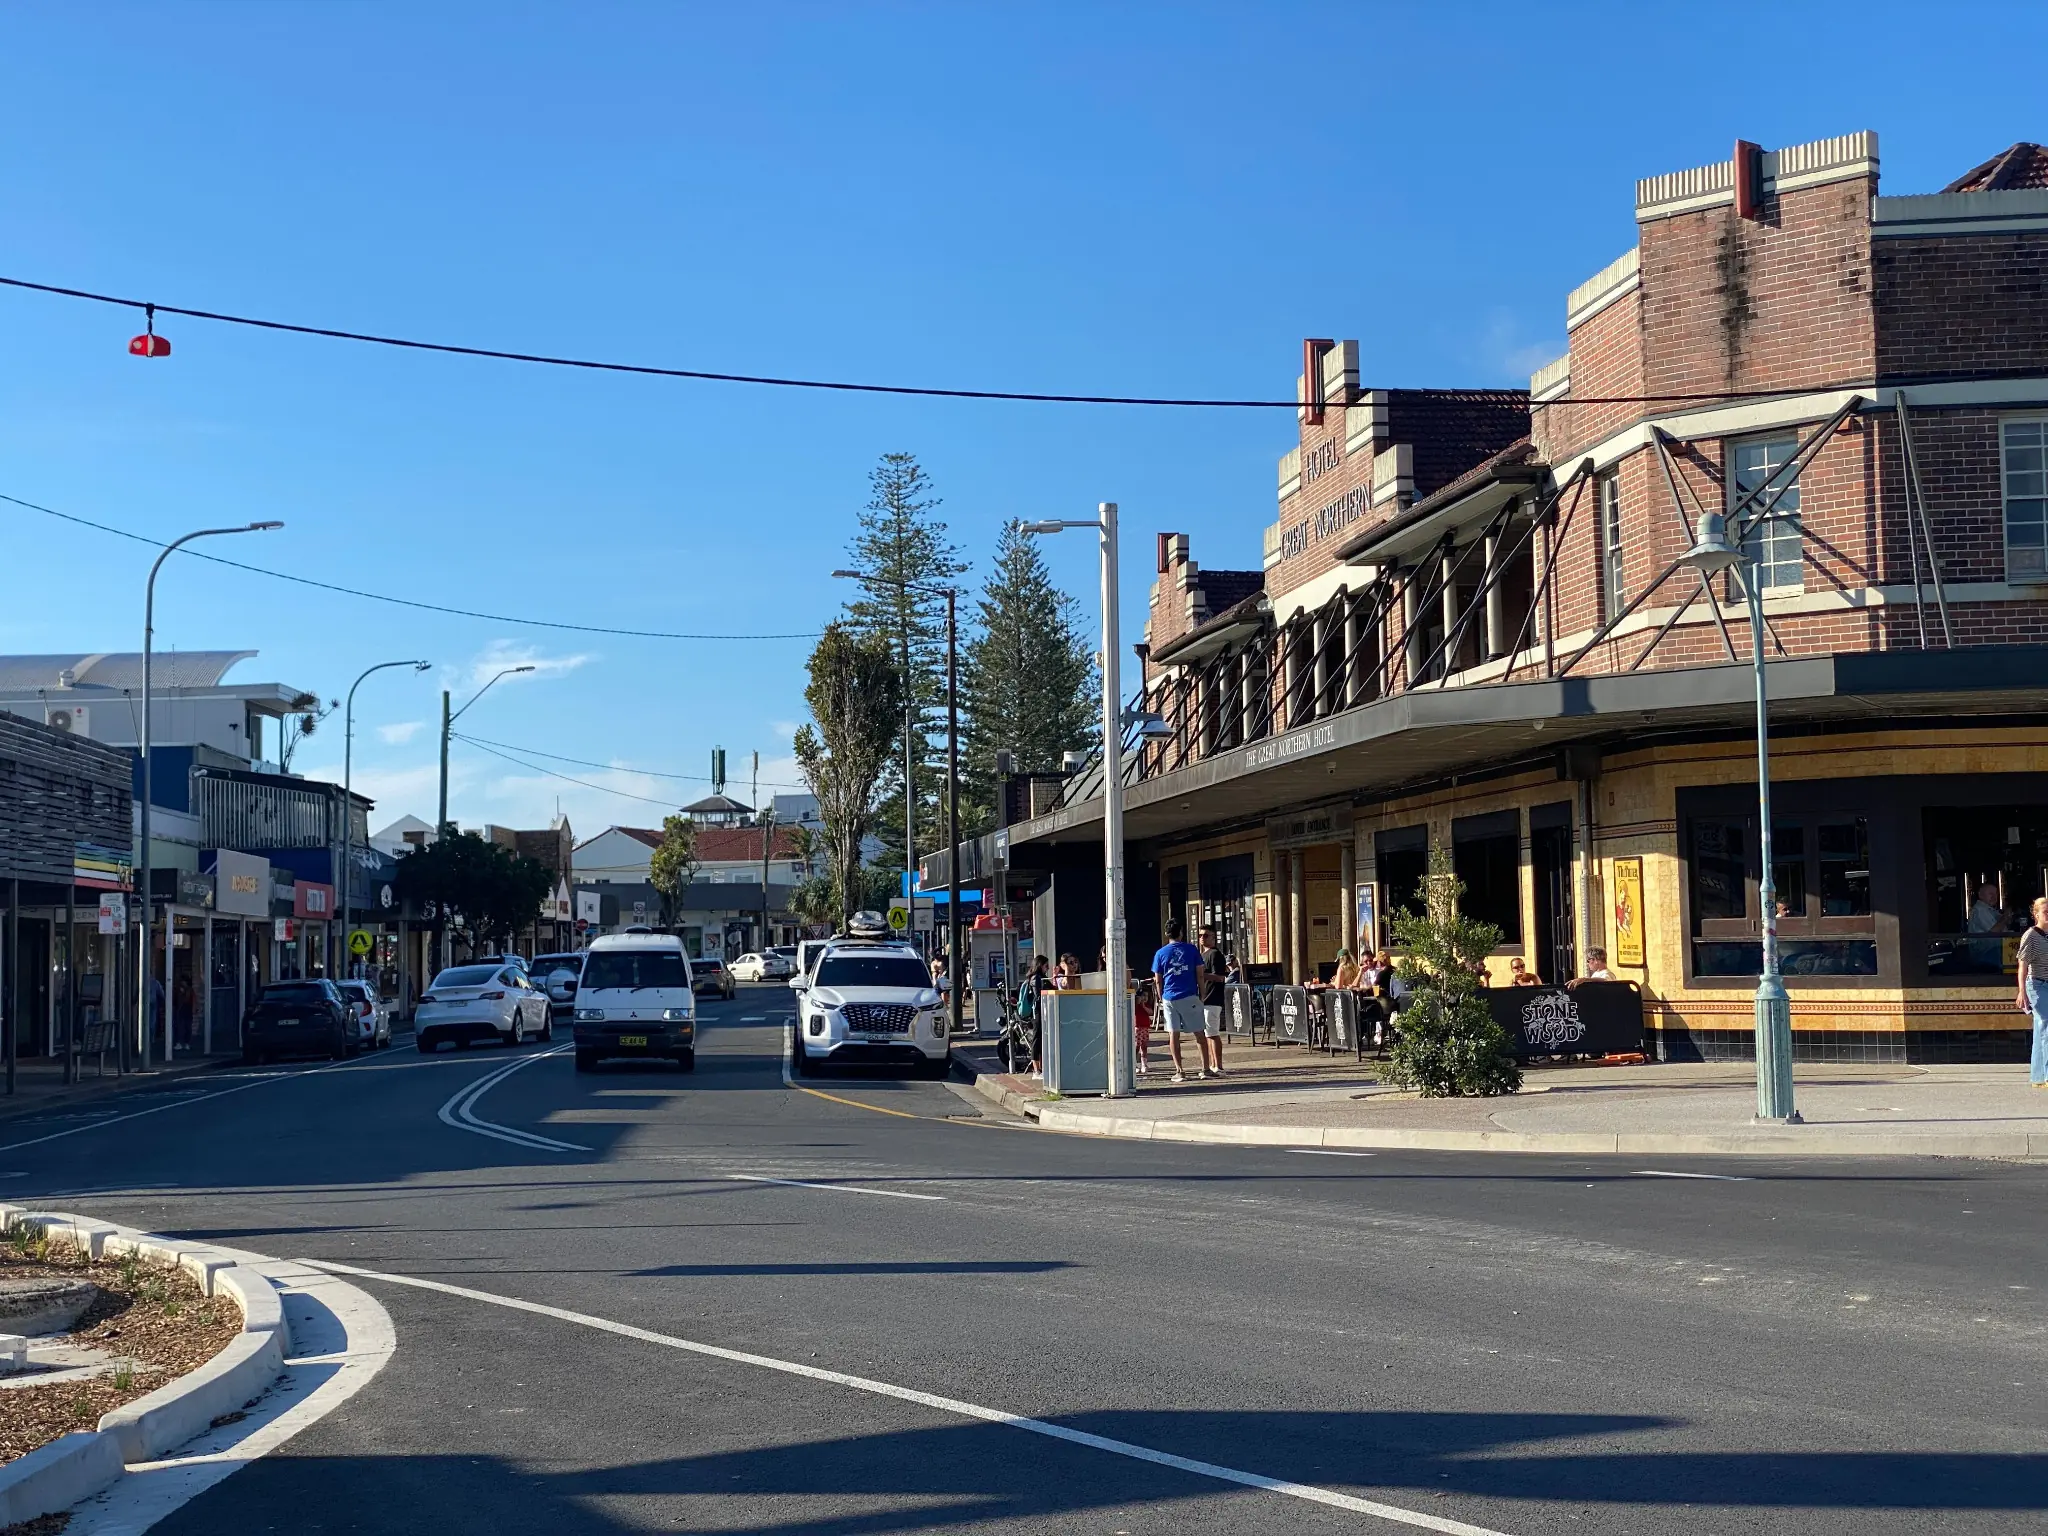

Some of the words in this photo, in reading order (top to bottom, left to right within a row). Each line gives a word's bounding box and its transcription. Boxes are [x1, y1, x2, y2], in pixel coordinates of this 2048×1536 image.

[1306, 437, 1340, 484] HOTEL
[1281, 518, 1309, 561] GREAT
[1314, 479, 1372, 543] NORTHERN
[1245, 749, 1257, 768] THE
[1258, 743, 1276, 764] GREAT
[1278, 732, 1311, 758] NORTHERN
[1313, 724, 1335, 747] HOTEL
[1521, 1002, 1579, 1024] STONE
[1523, 1021, 1580, 1044] WOOD
